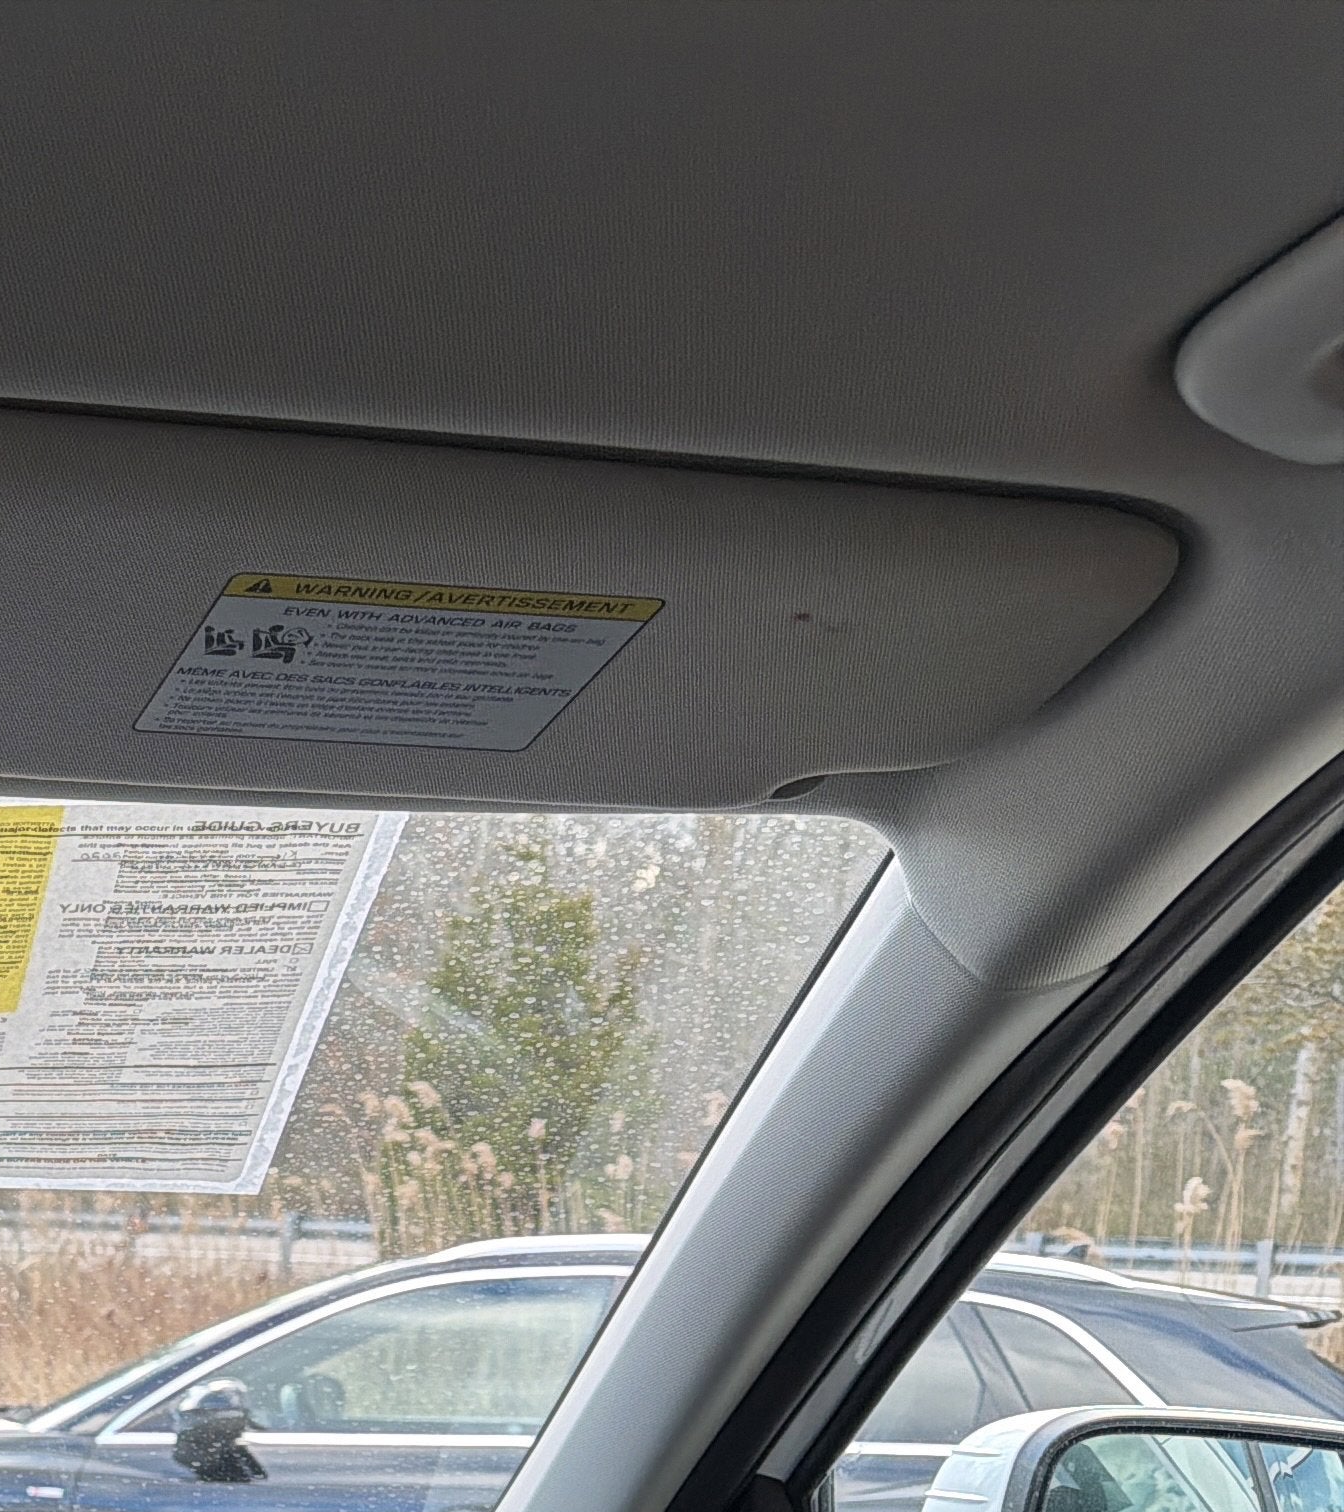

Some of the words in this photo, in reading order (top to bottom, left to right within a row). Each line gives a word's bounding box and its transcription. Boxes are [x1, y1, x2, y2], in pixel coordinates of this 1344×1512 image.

[296, 582, 414, 601] WARNING
[283, 606, 332, 618] EVEN
[336, 609, 384, 621] WITH
[388, 612, 486, 627] ADVANCED
[491, 619, 522, 629] AIR
[528, 621, 579, 633] BAGS
[230, 669, 272, 681] AVEC
[275, 671, 310, 683] DES
[312, 674, 356, 686] SACS
[358, 678, 462, 692] GONFLABLES
[462, 683, 573, 698] INTELLIGENTS
[80, 824, 103, 832] that
[106, 825, 132, 833] may
